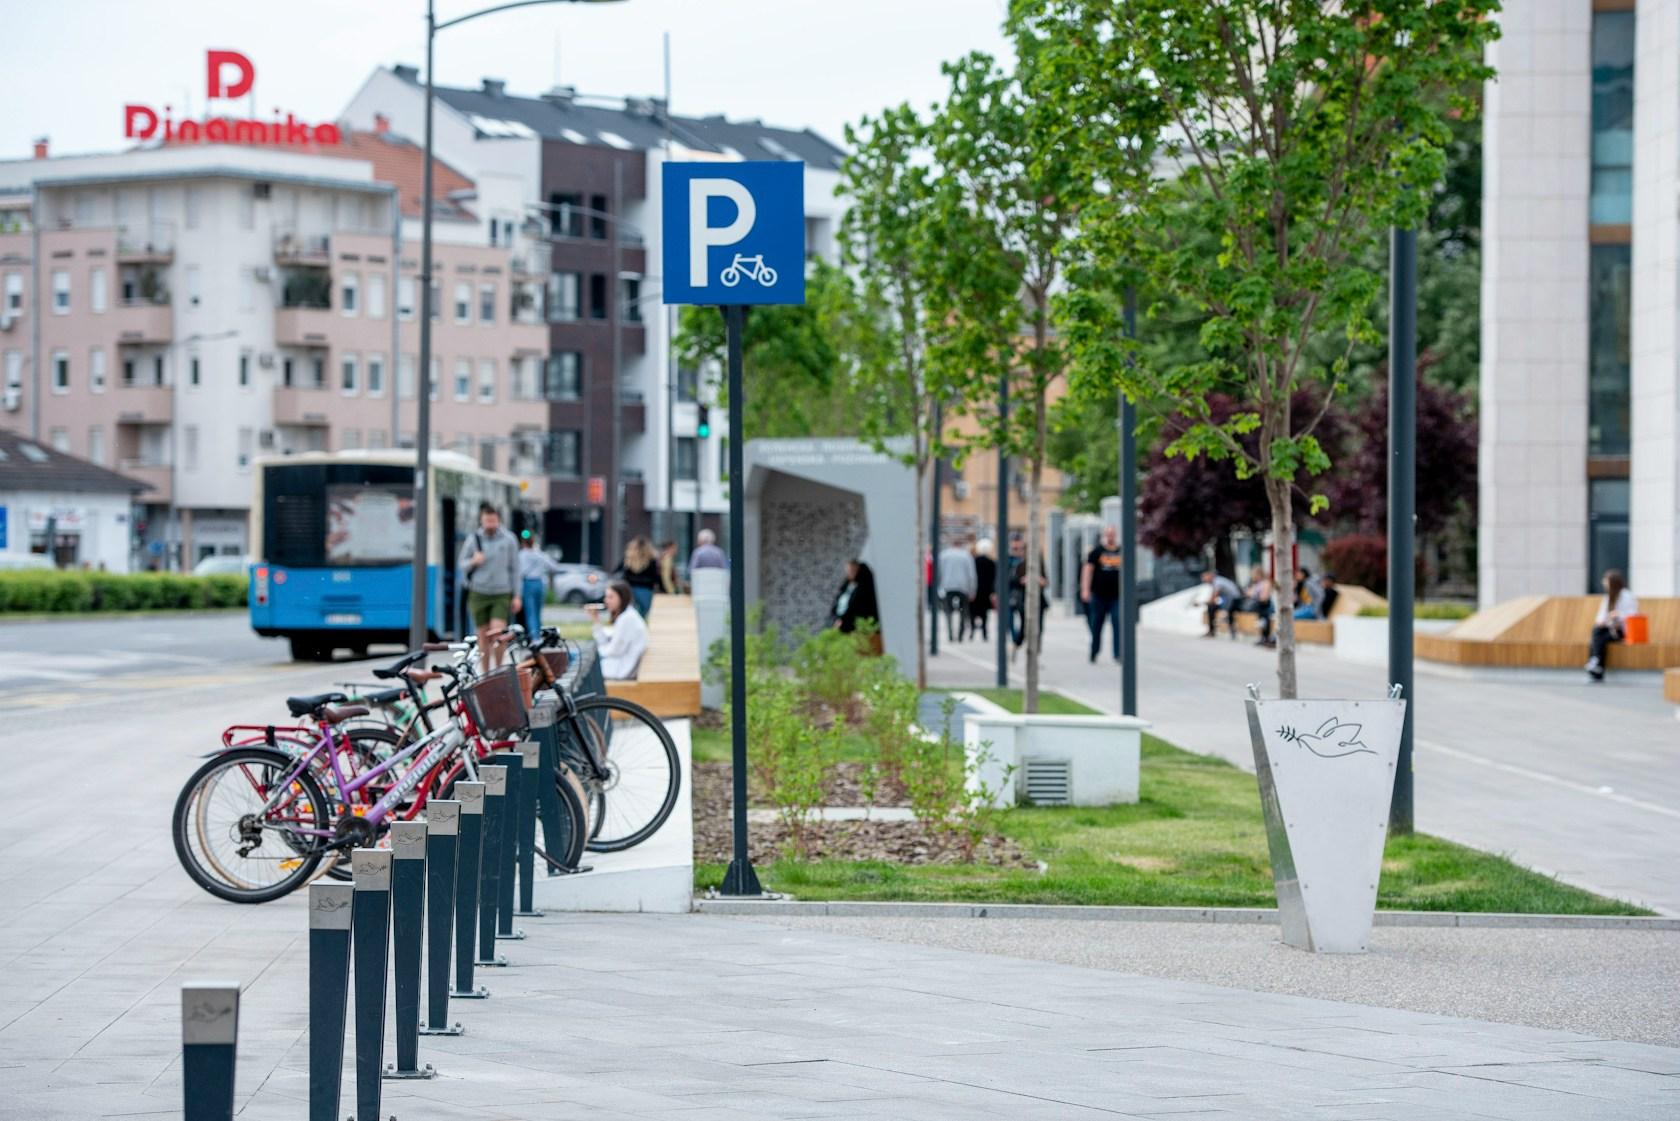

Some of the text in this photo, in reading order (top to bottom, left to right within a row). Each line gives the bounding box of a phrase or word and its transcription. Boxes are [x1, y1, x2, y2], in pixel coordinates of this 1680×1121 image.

[207, 50, 254, 98] D
[125, 105, 341, 144] Dinamika
[689, 178, 757, 287] P
